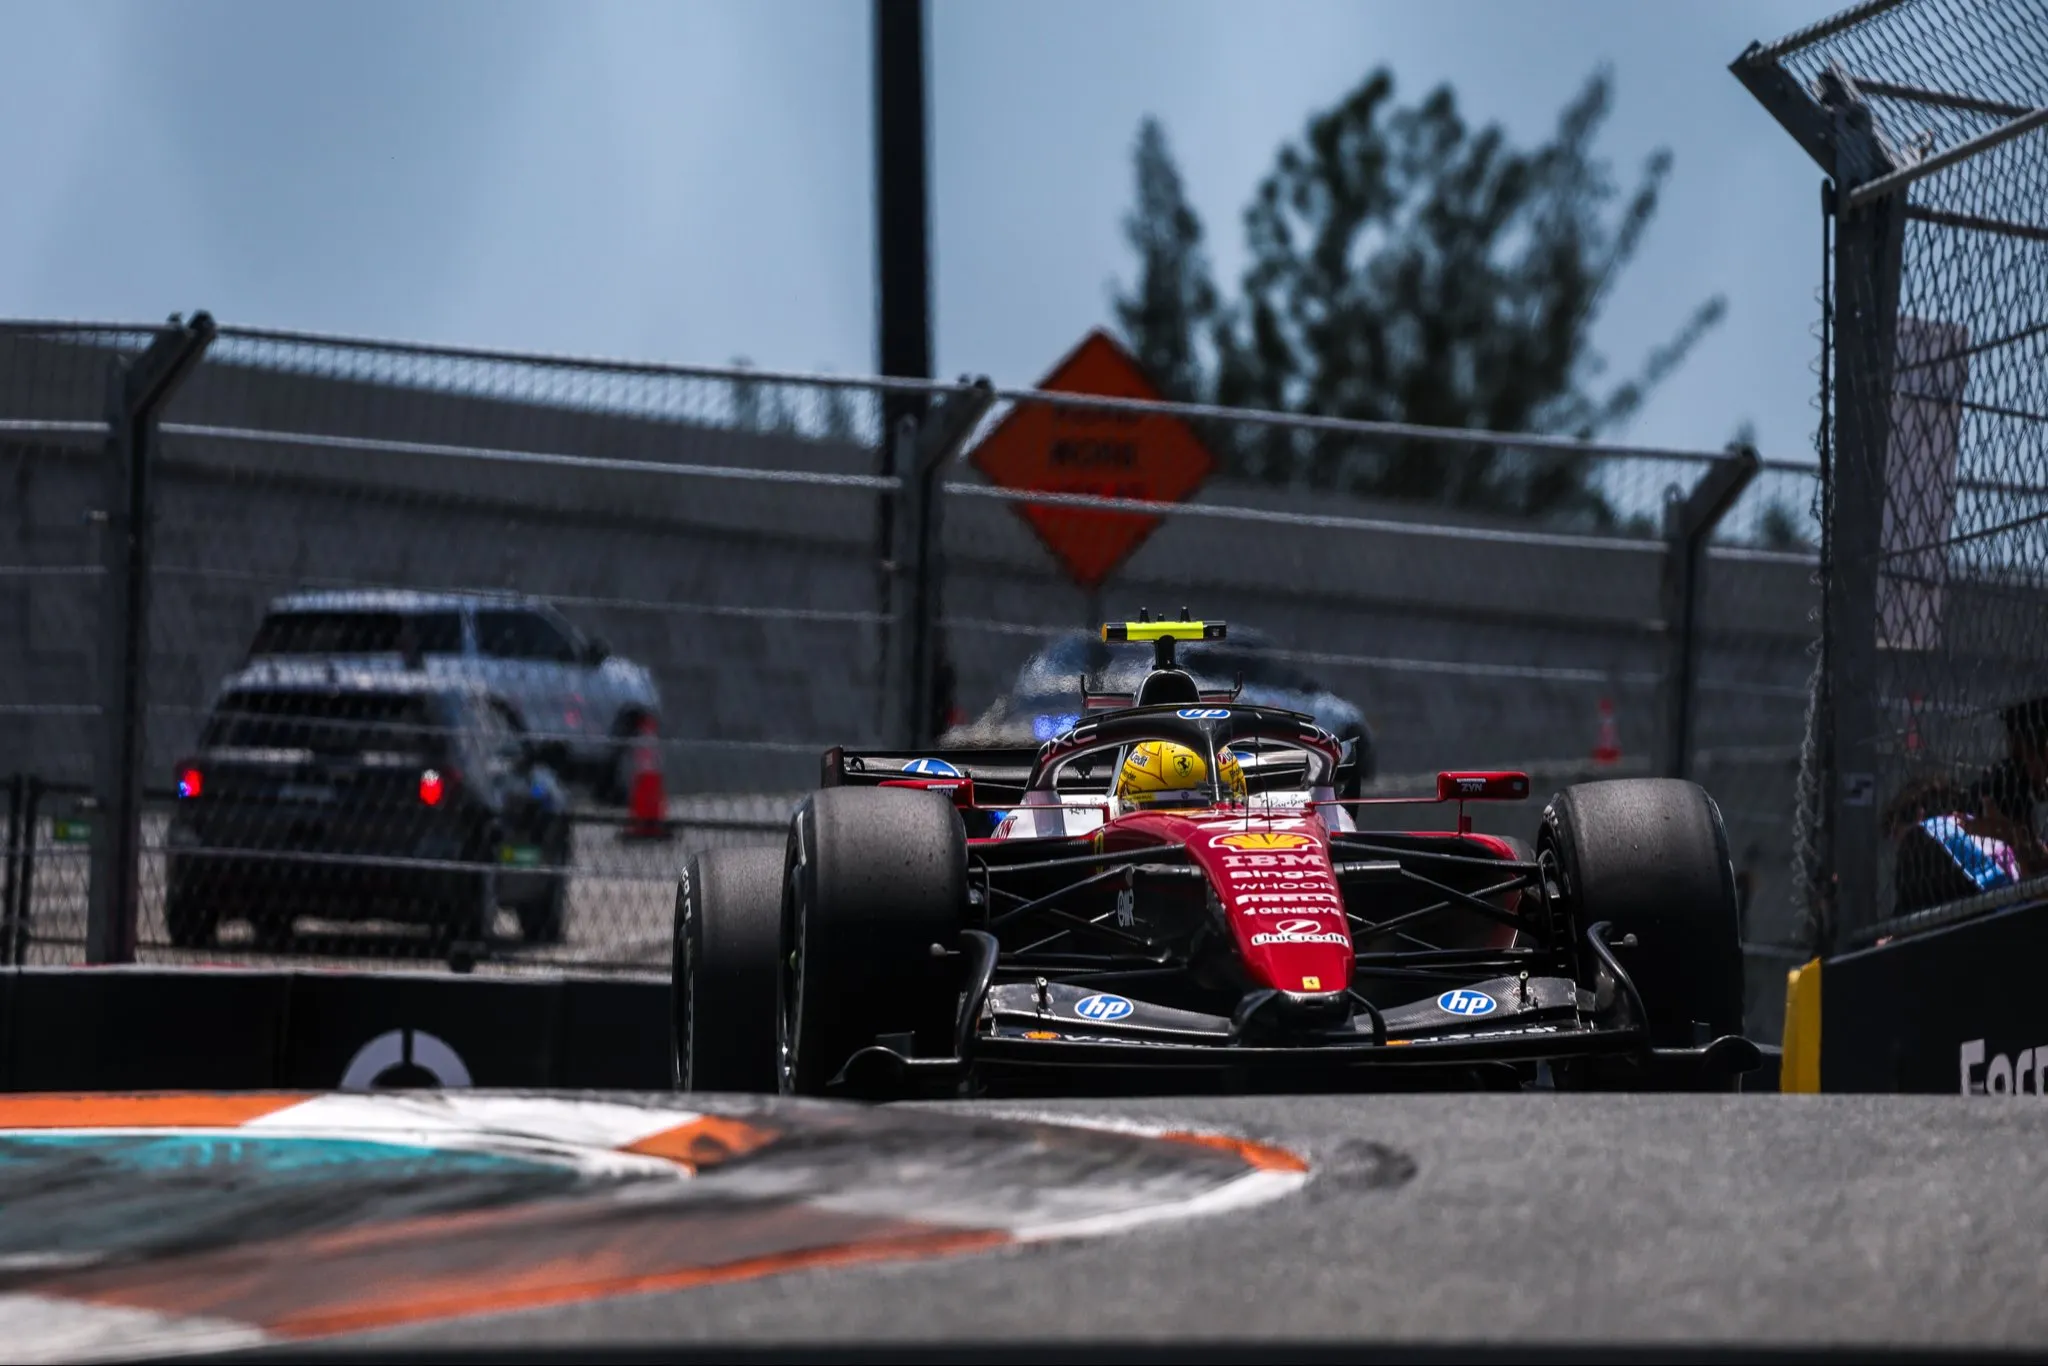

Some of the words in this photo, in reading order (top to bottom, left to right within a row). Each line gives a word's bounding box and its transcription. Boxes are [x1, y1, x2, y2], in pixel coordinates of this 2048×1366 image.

[1183, 708, 1222, 719] hp
[1197, 817, 1307, 831] 44
[1222, 854, 1327, 868] IBM
[1230, 869, 1329, 880] BingX
[1232, 882, 1335, 891] WHOOP
[1258, 907, 1341, 917] GENESYS
[1252, 932, 1348, 946] UniCredit
[1084, 994, 1127, 1020] hp
[1448, 990, 1490, 1016] hp
